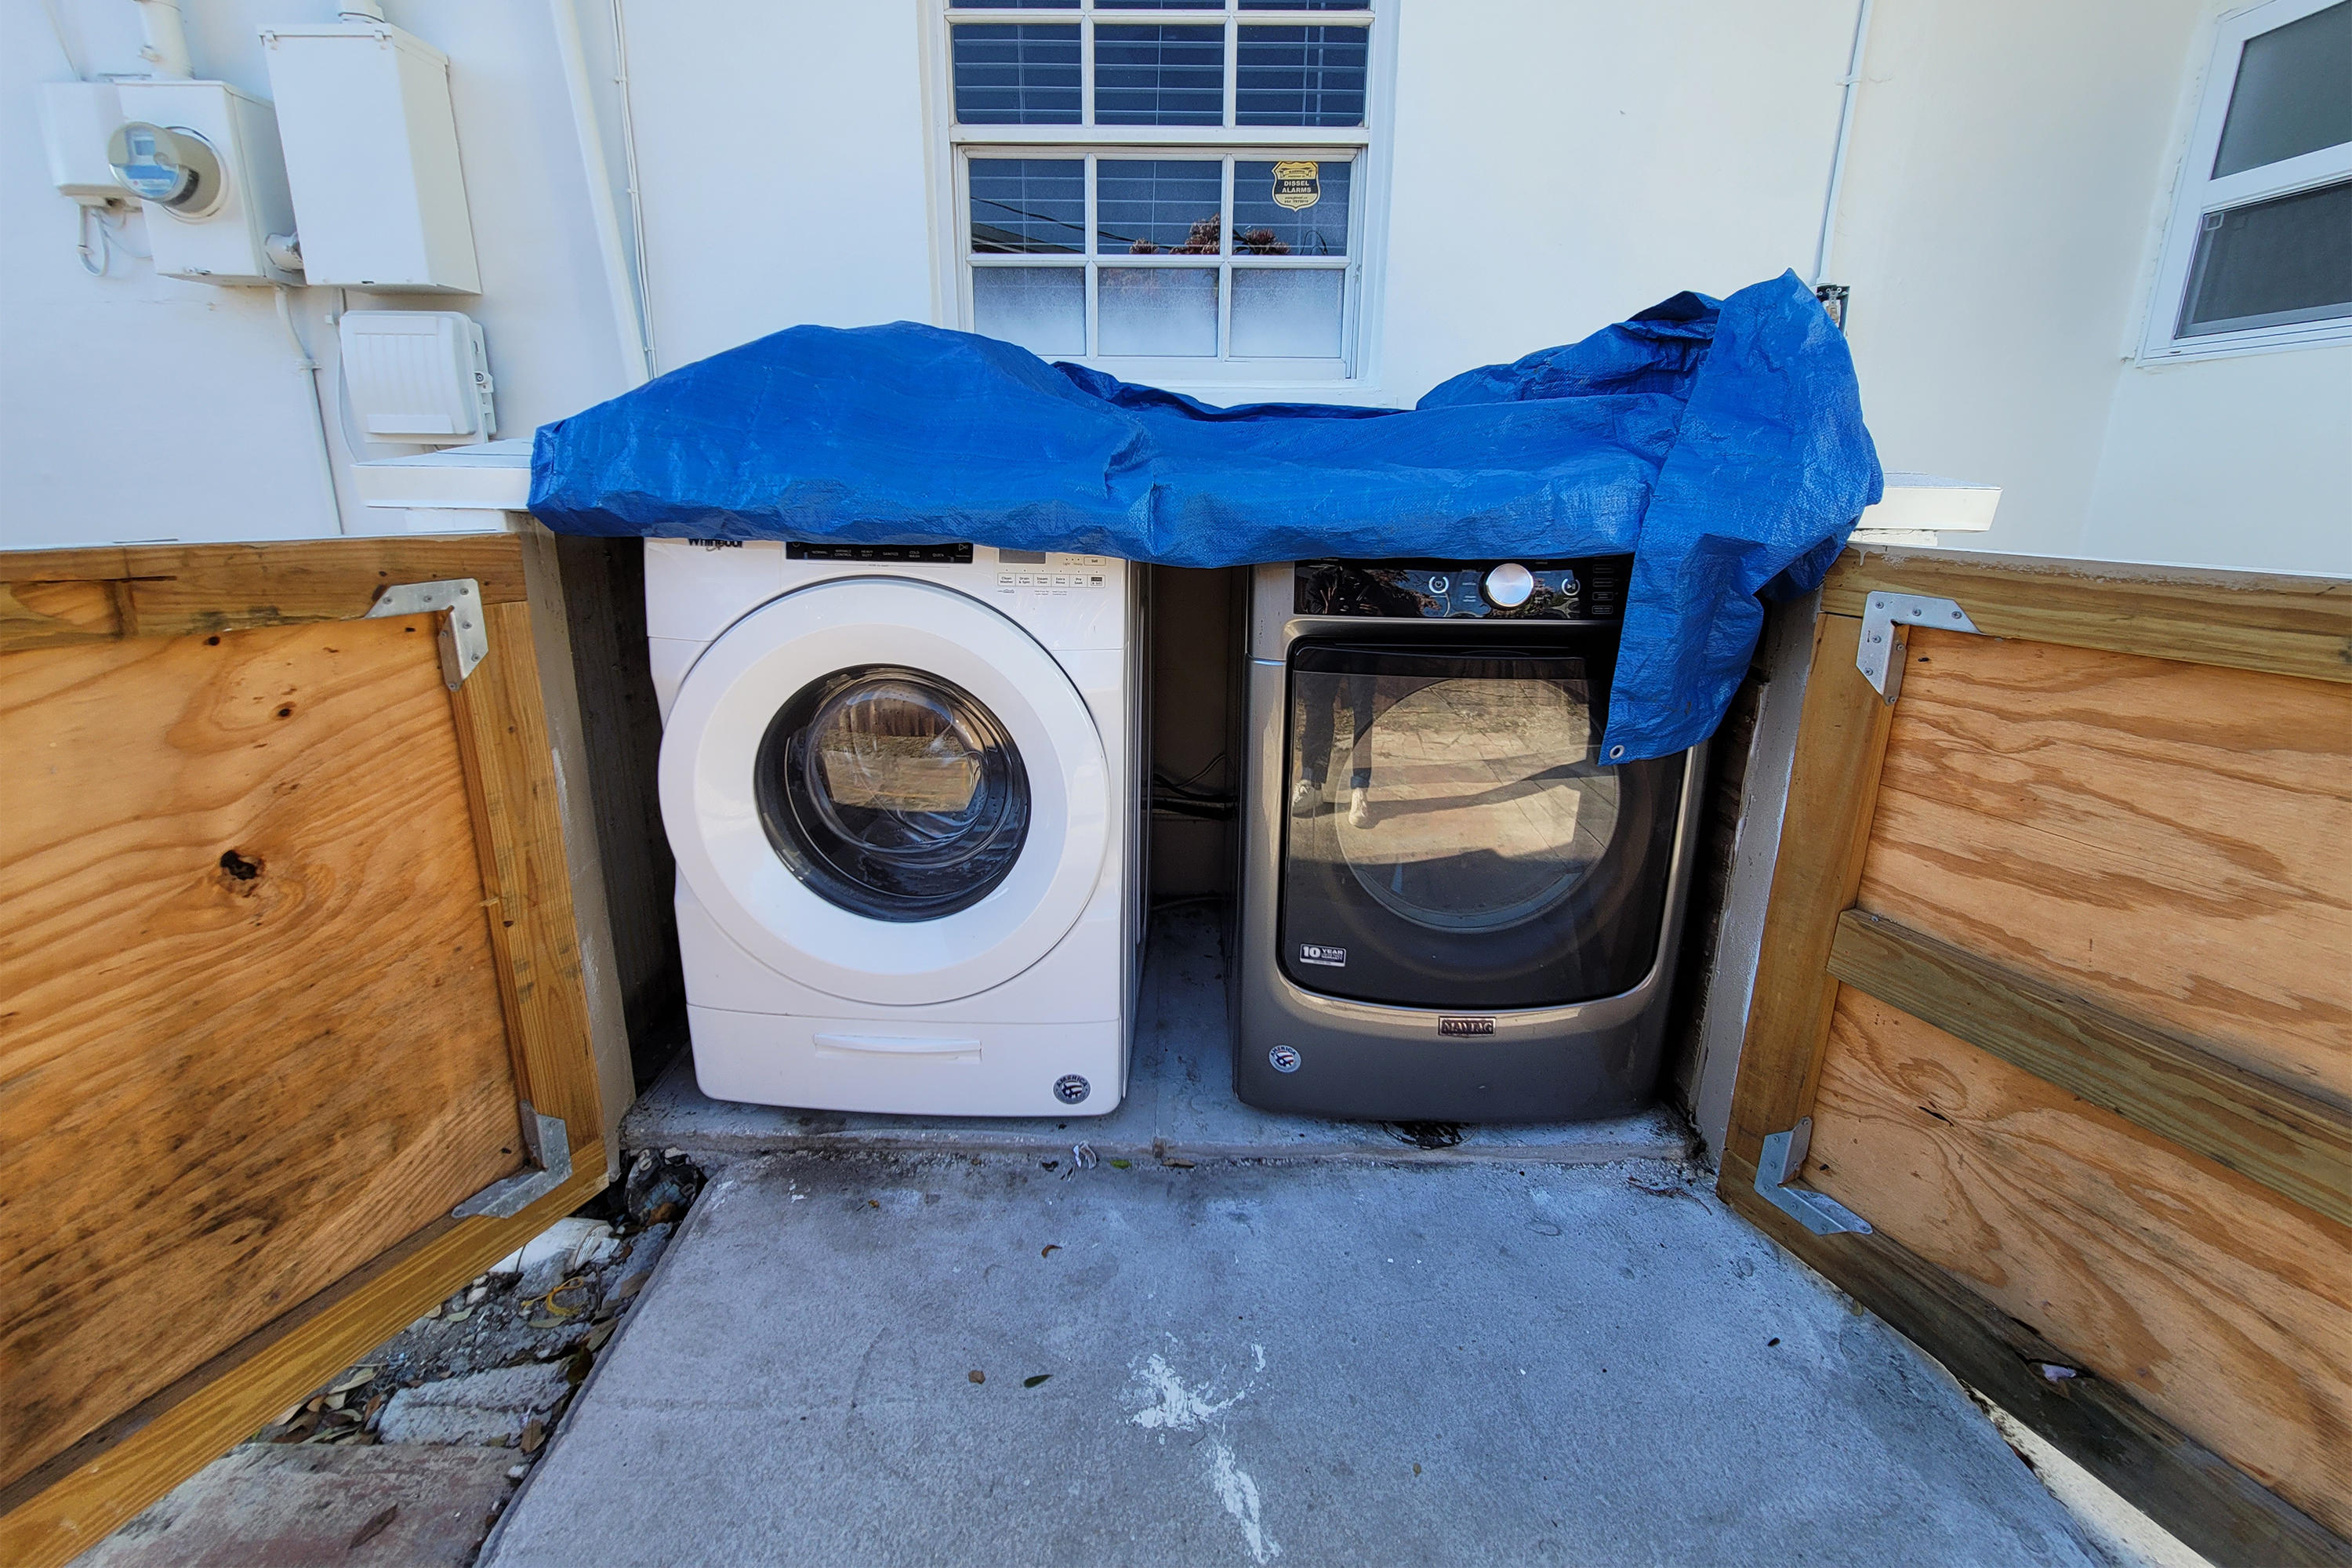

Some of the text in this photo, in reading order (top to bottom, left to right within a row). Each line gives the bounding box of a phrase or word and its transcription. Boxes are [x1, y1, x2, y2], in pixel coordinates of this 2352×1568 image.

[1303, 946, 1321, 957] 10
[1270, 1046, 1297, 1057] AMERICA
[1056, 1074, 1088, 1087] AMERICA
